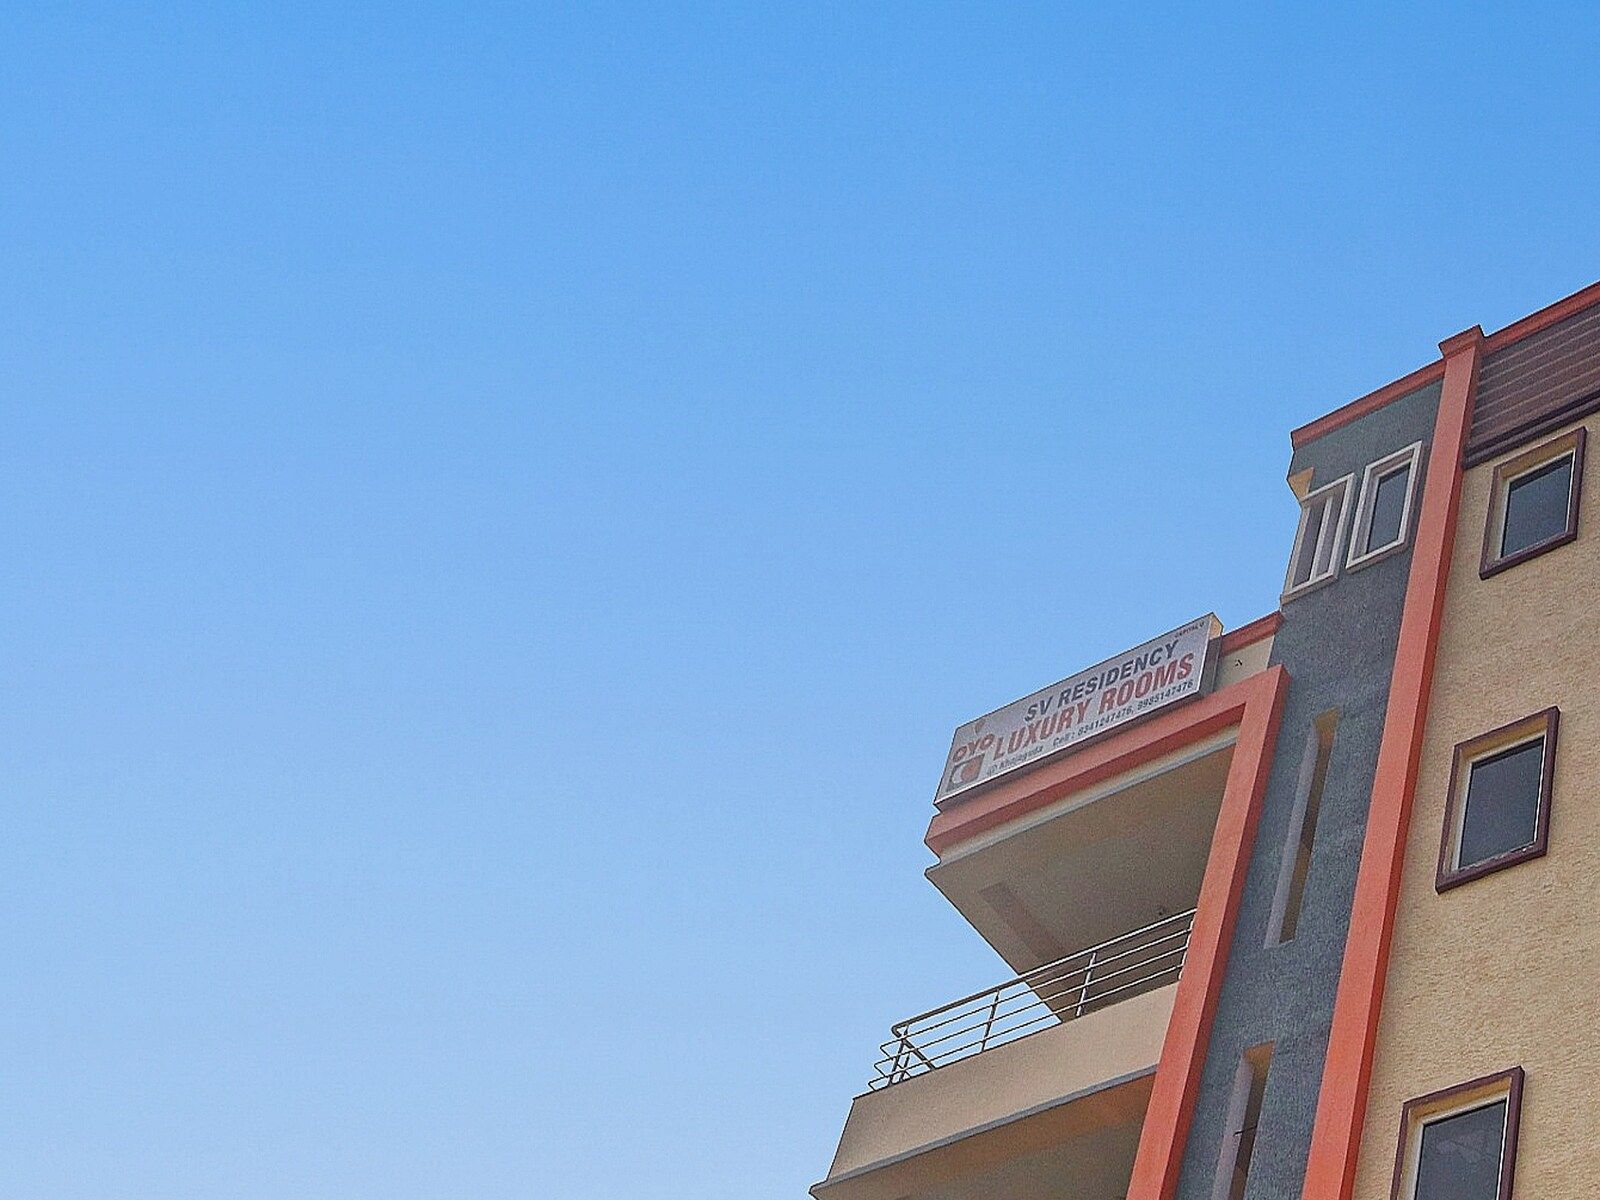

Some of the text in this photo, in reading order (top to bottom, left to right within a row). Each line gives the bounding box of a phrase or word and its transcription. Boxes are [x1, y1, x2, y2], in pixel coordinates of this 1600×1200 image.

[992, 696, 1093, 761] LUXURY
[1098, 652, 1195, 715] ROOMS
[1024, 639, 1179, 722] SV RESIDENCY
[953, 733, 996, 763] OYO
